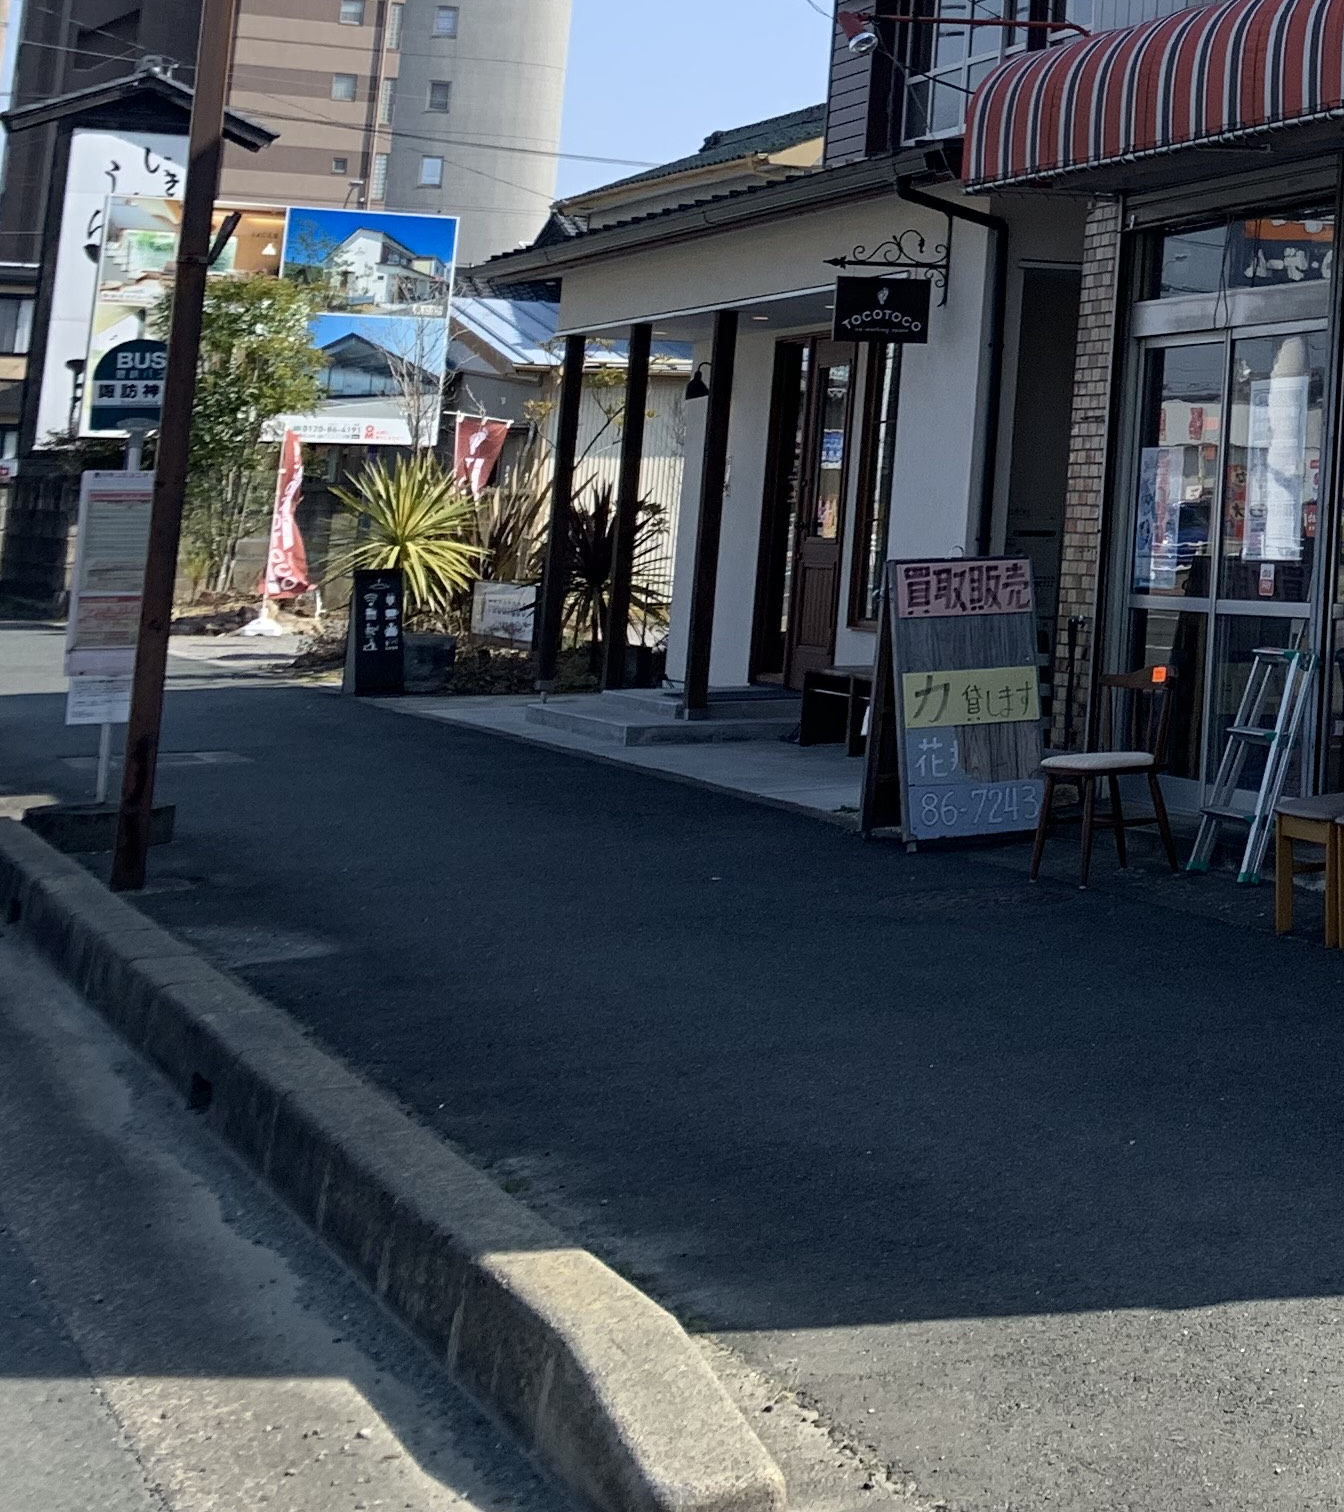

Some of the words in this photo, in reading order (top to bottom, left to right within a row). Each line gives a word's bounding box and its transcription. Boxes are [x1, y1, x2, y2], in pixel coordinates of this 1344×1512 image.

[841, 309, 922, 332] TOCOTOCO
[116, 351, 167, 369] BUS
[904, 563, 1030, 615] 買取販売
[961, 682, 1032, 721] 貸します
[921, 786, 1038, 826] 86-7243
